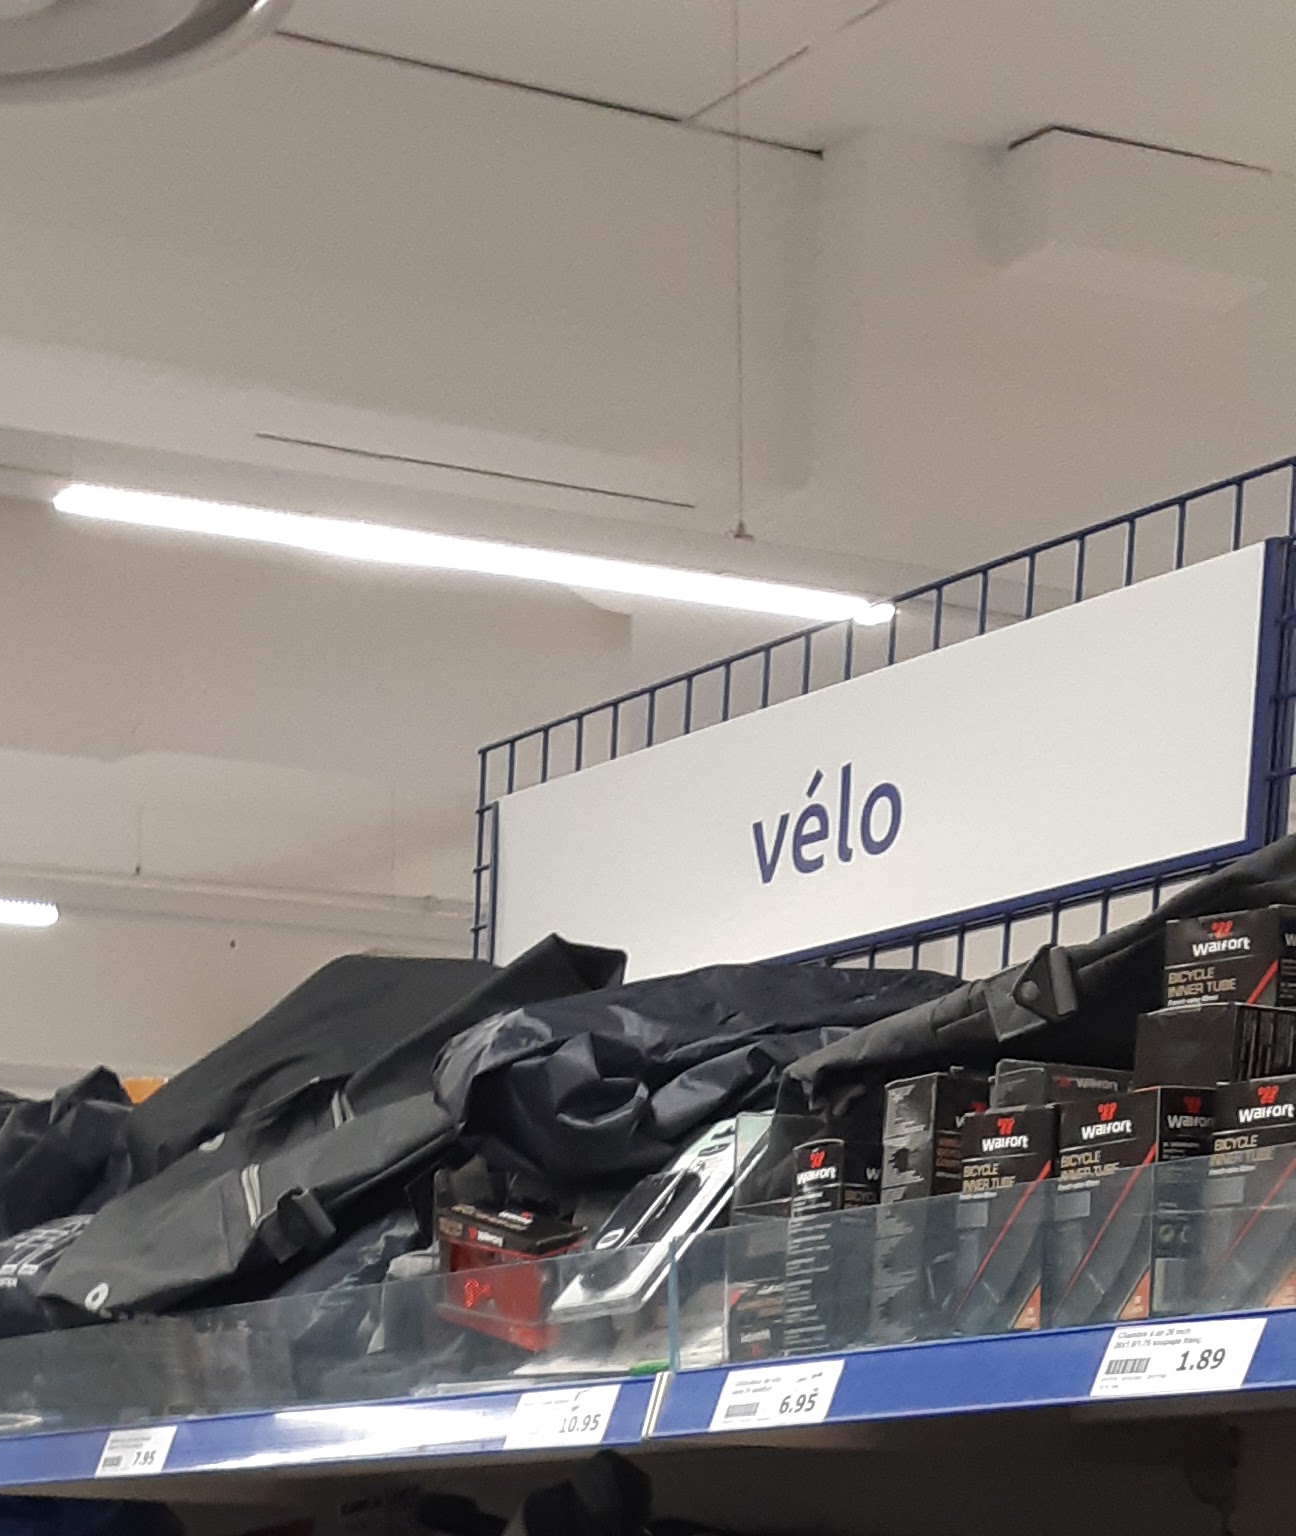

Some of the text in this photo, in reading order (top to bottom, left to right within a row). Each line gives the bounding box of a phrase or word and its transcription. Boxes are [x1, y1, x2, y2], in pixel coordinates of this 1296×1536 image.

[751, 762, 904, 886] vélo
[1176, 1347, 1226, 1372] 1.89
[779, 1392, 819, 1415] 6.95
[558, 1413, 602, 1434] 10.95
